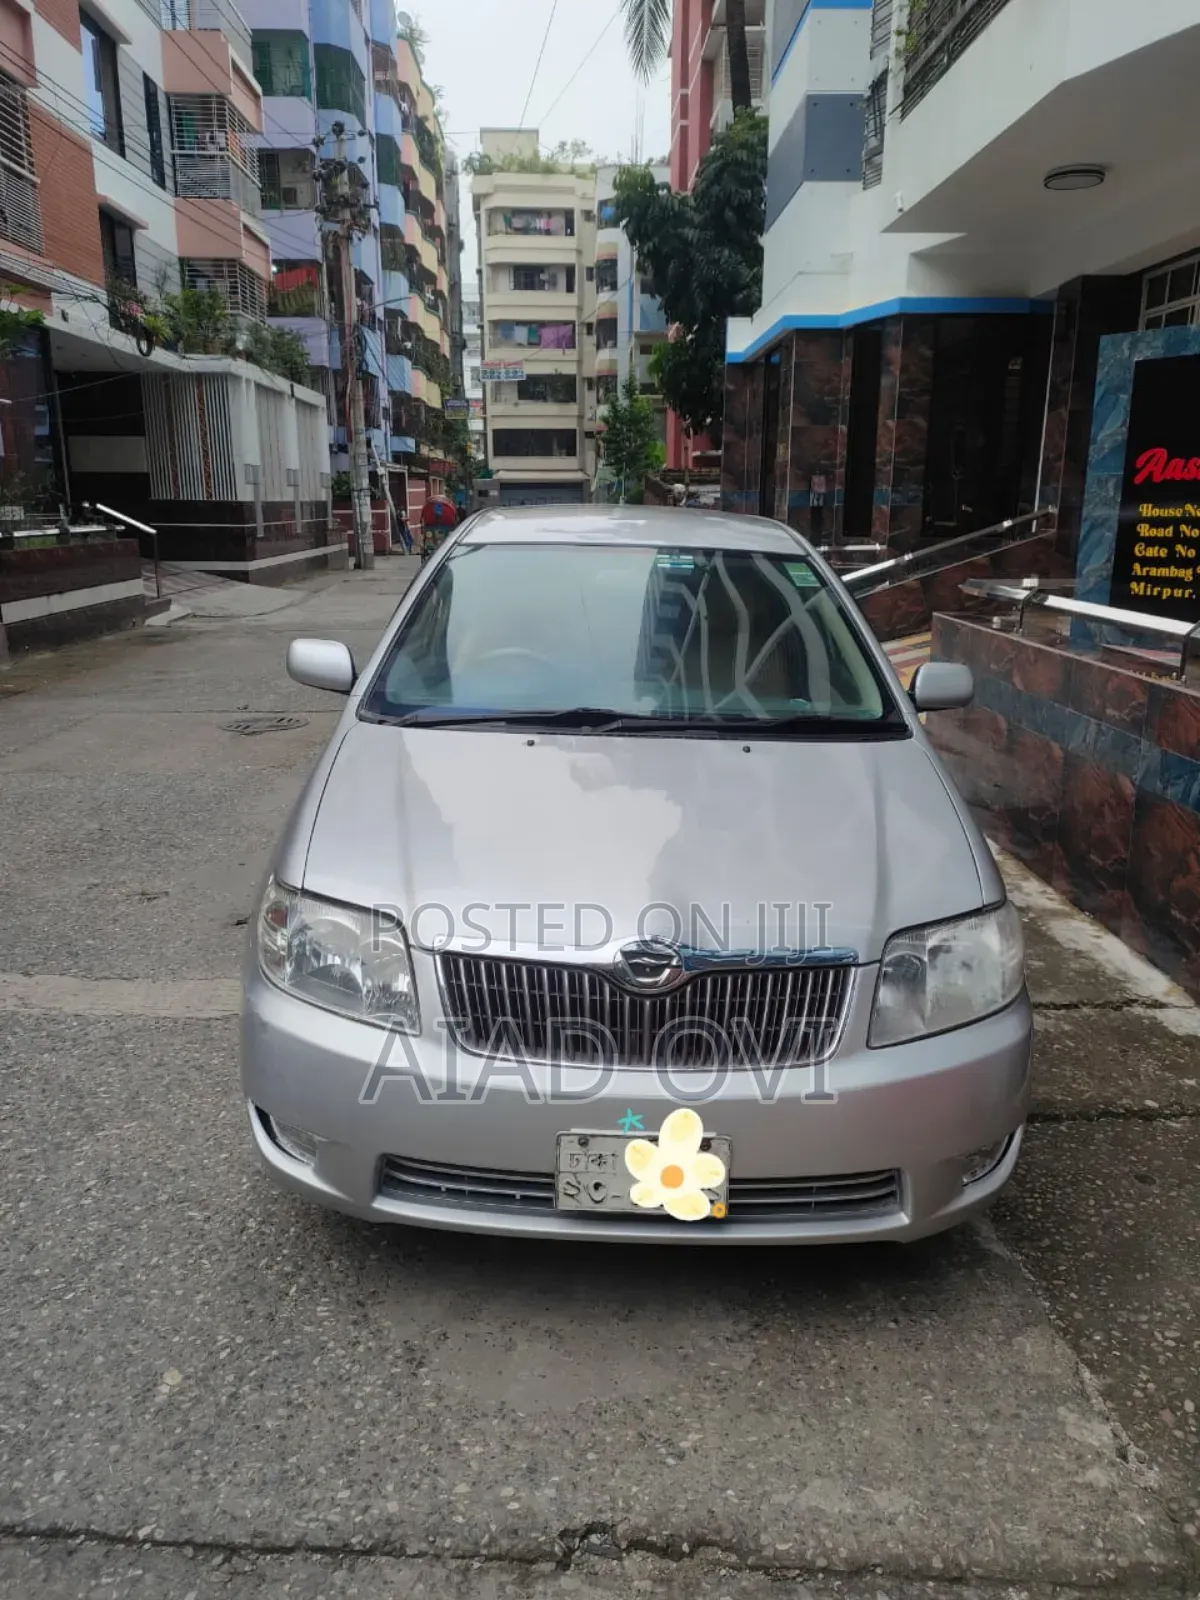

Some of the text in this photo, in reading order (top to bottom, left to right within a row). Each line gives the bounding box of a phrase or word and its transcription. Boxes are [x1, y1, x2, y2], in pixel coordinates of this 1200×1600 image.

[1139, 503, 1183, 517] House
[1136, 523, 1200, 538] Road No
[1175, 543, 1196, 558] No
[1131, 562, 1193, 582] Arambag
